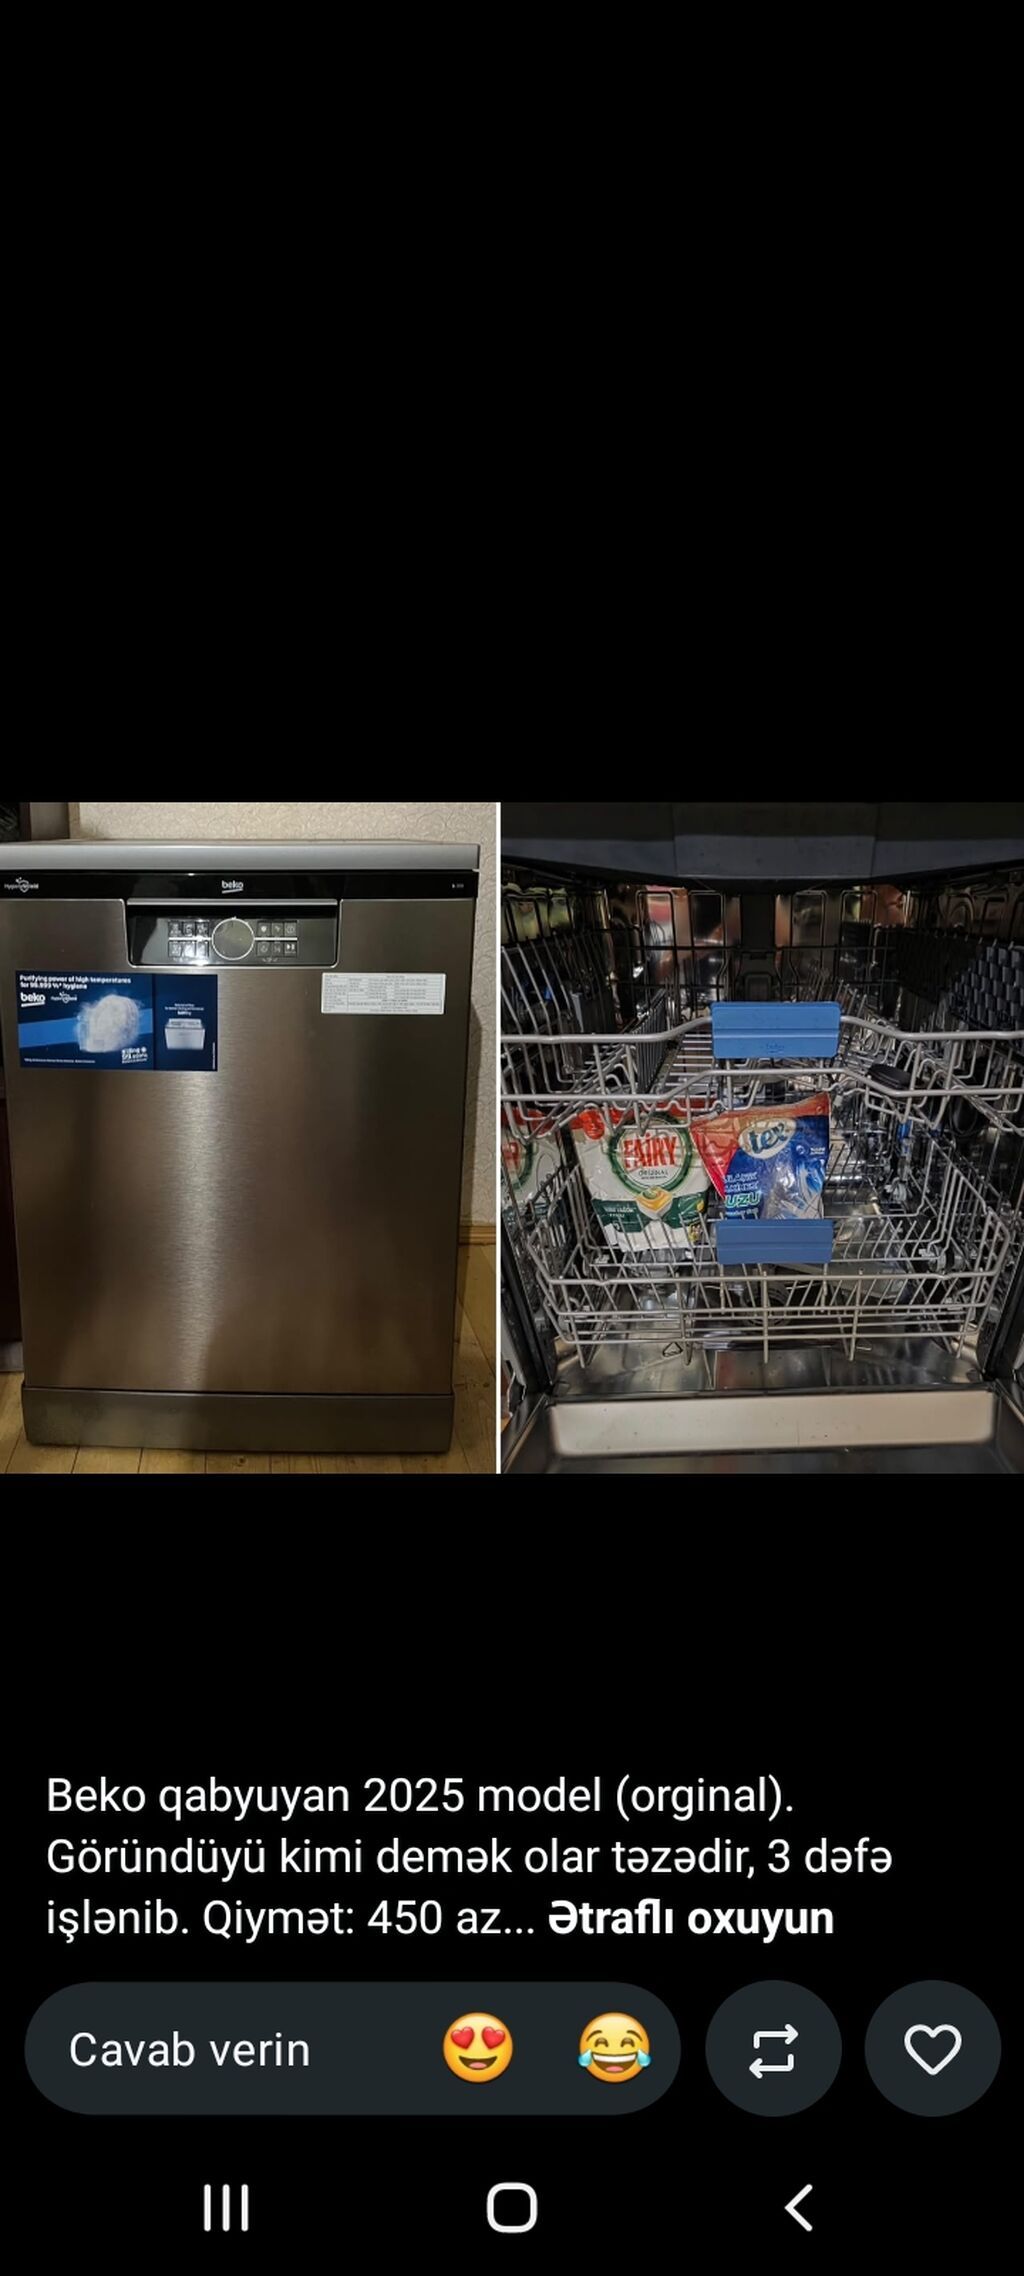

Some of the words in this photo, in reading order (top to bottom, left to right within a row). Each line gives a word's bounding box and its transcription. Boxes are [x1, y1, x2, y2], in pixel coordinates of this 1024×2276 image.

[221, 879, 244, 890] beko
[48, 976, 67, 984] power
[68, 975, 75, 983] of
[75, 975, 89, 984] high
[20, 991, 46, 1003] beko
[622, 1131, 678, 1170] FAIRY
